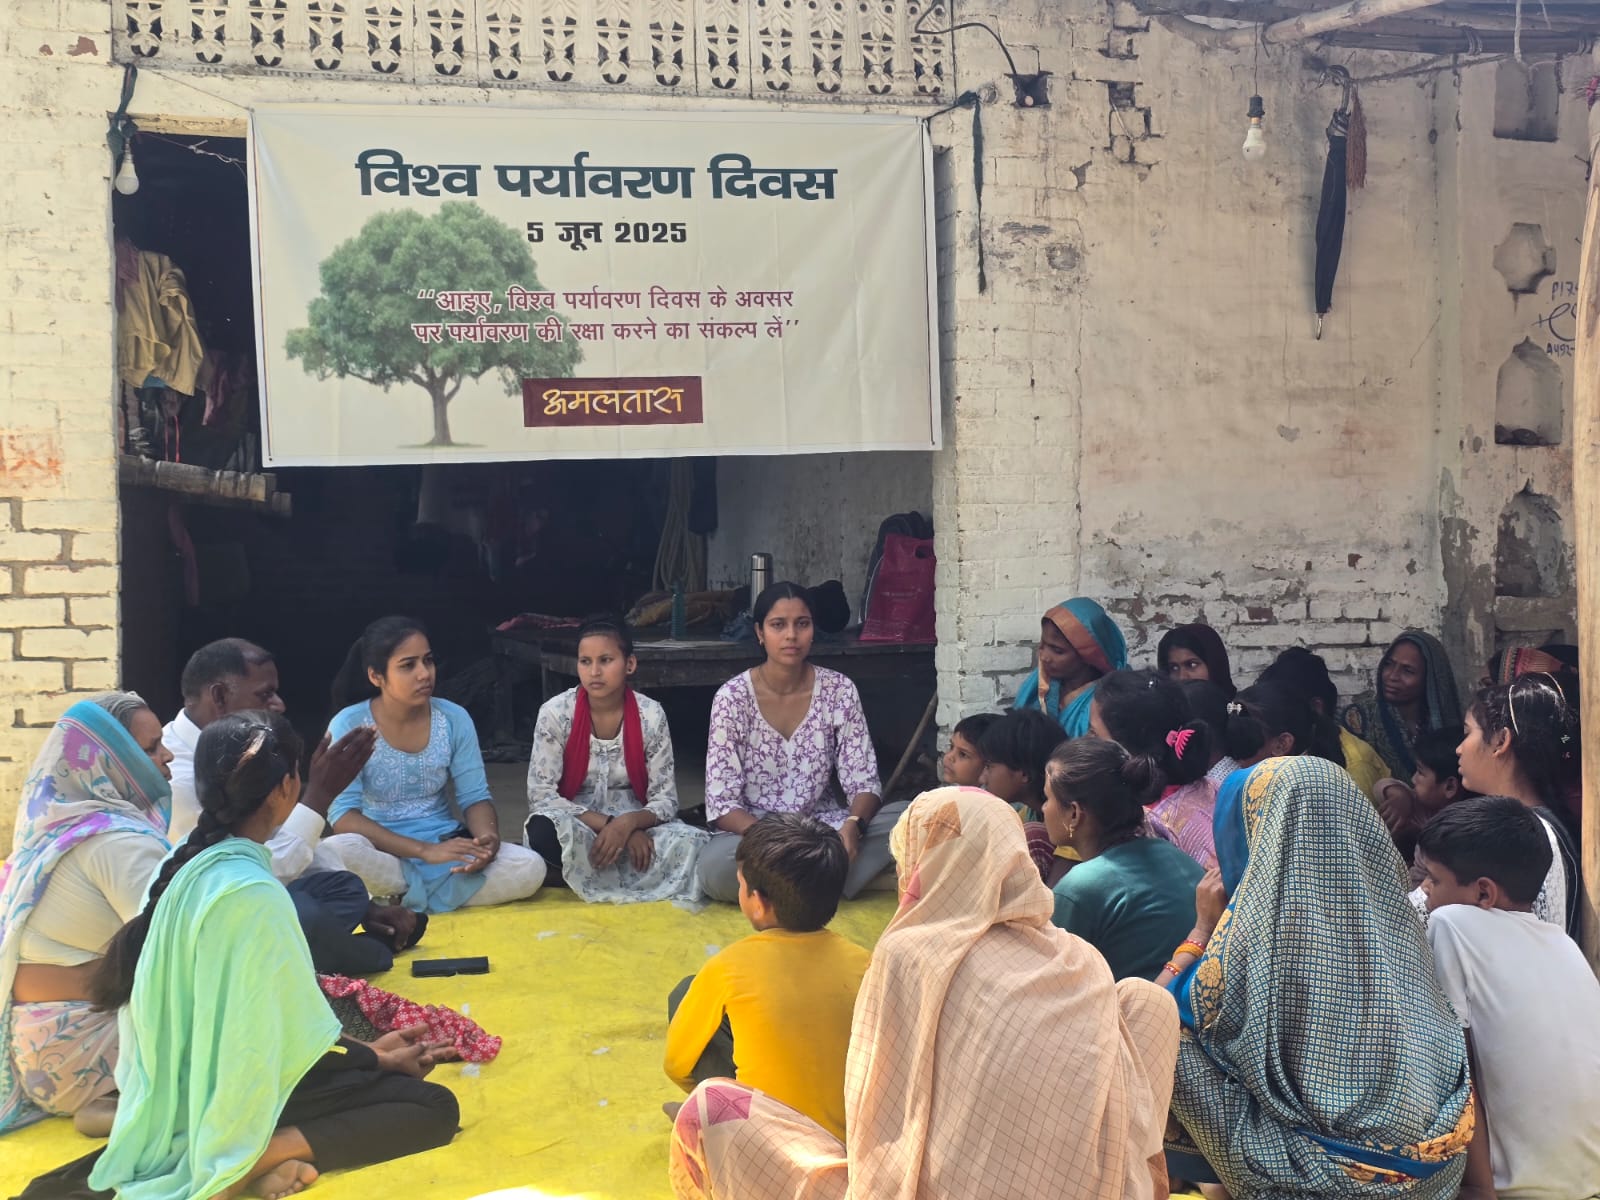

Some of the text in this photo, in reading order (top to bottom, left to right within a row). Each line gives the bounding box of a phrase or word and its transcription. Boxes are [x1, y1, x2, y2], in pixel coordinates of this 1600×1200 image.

[355, 149, 838, 200] विश्व पर्यावरण दिवस
[526, 222, 687, 251] 5 जून 2025
[507, 285, 555, 310] विश्व
[563, 286, 640, 309] पर्यावरण
[649, 286, 700, 309] दिवस
[707, 285, 727, 307] के
[735, 290, 794, 308] अवसर
[413, 323, 443, 342] पर
[447, 316, 528, 342] पर्यावरण
[534, 317, 563, 342] की
[569, 322, 605, 342] रक्षा
[612, 317, 657, 340] करने
[664, 322, 690, 340] का
[698, 318, 758, 340] संकल्प
